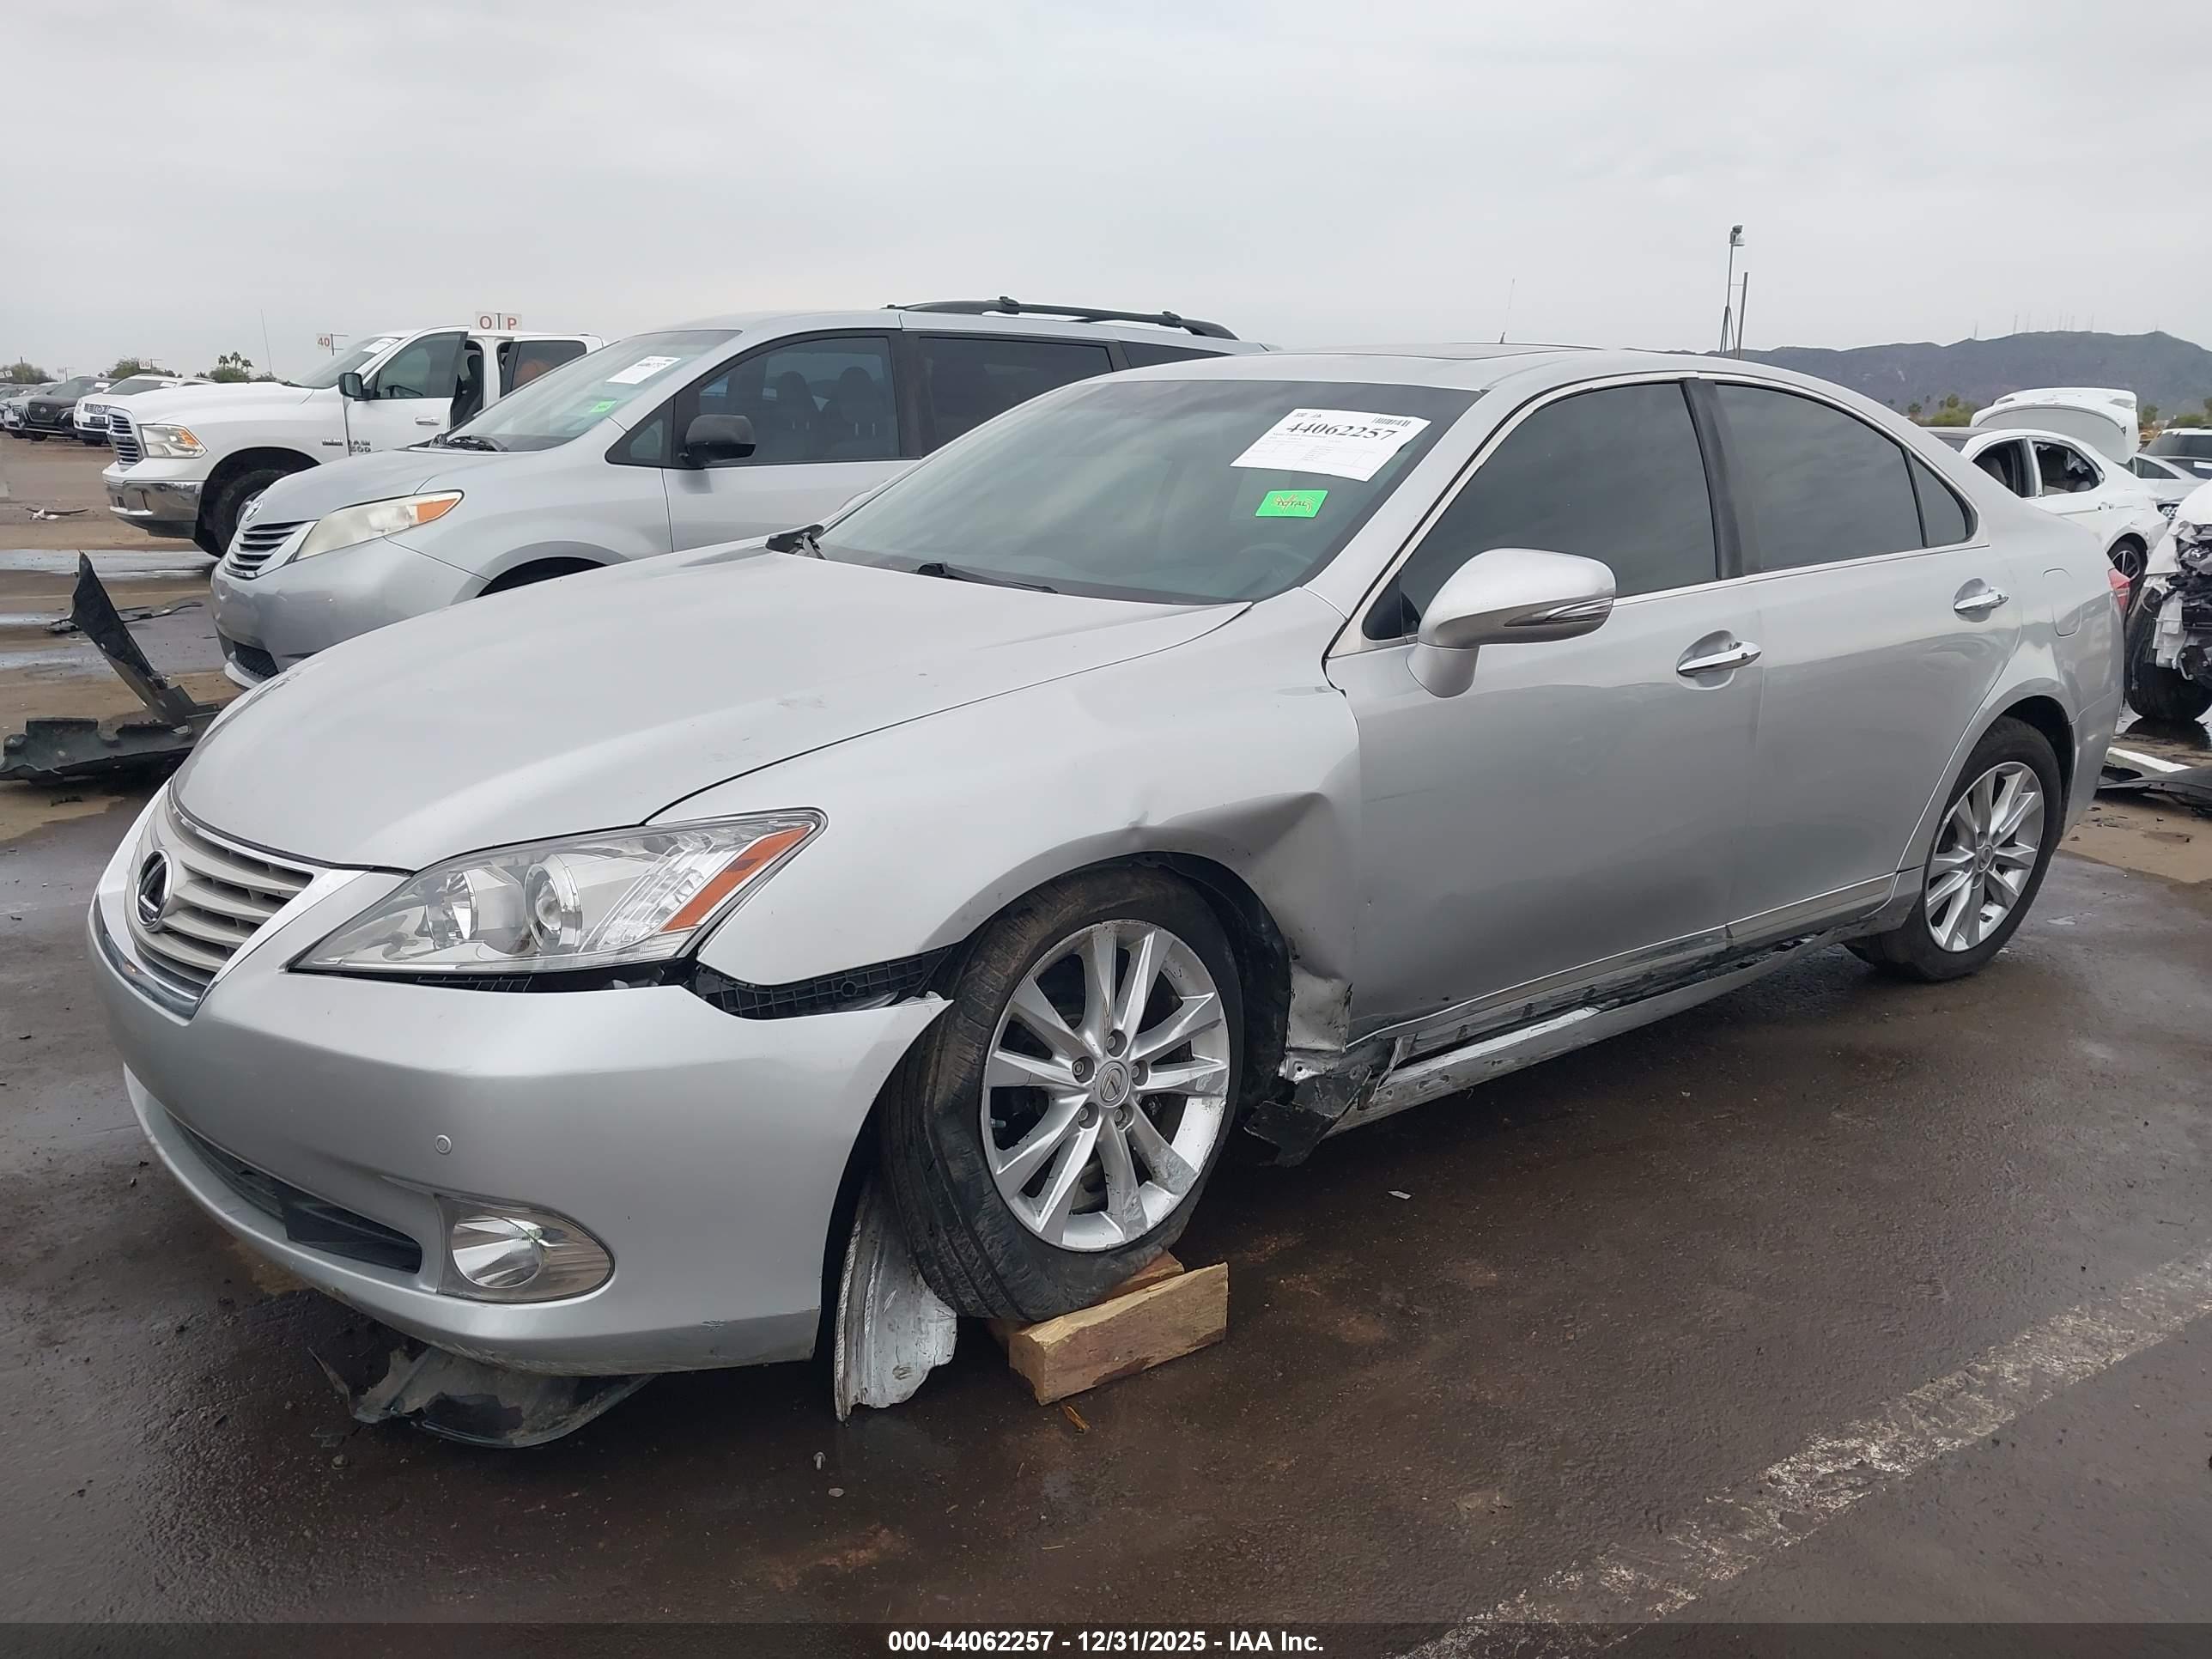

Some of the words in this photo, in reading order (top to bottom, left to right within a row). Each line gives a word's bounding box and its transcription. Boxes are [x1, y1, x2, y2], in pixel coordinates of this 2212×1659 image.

[479, 315, 492, 330] O
[507, 317, 517, 331] P
[317, 337, 330, 348] 40
[1286, 421, 1399, 441] 44062257
